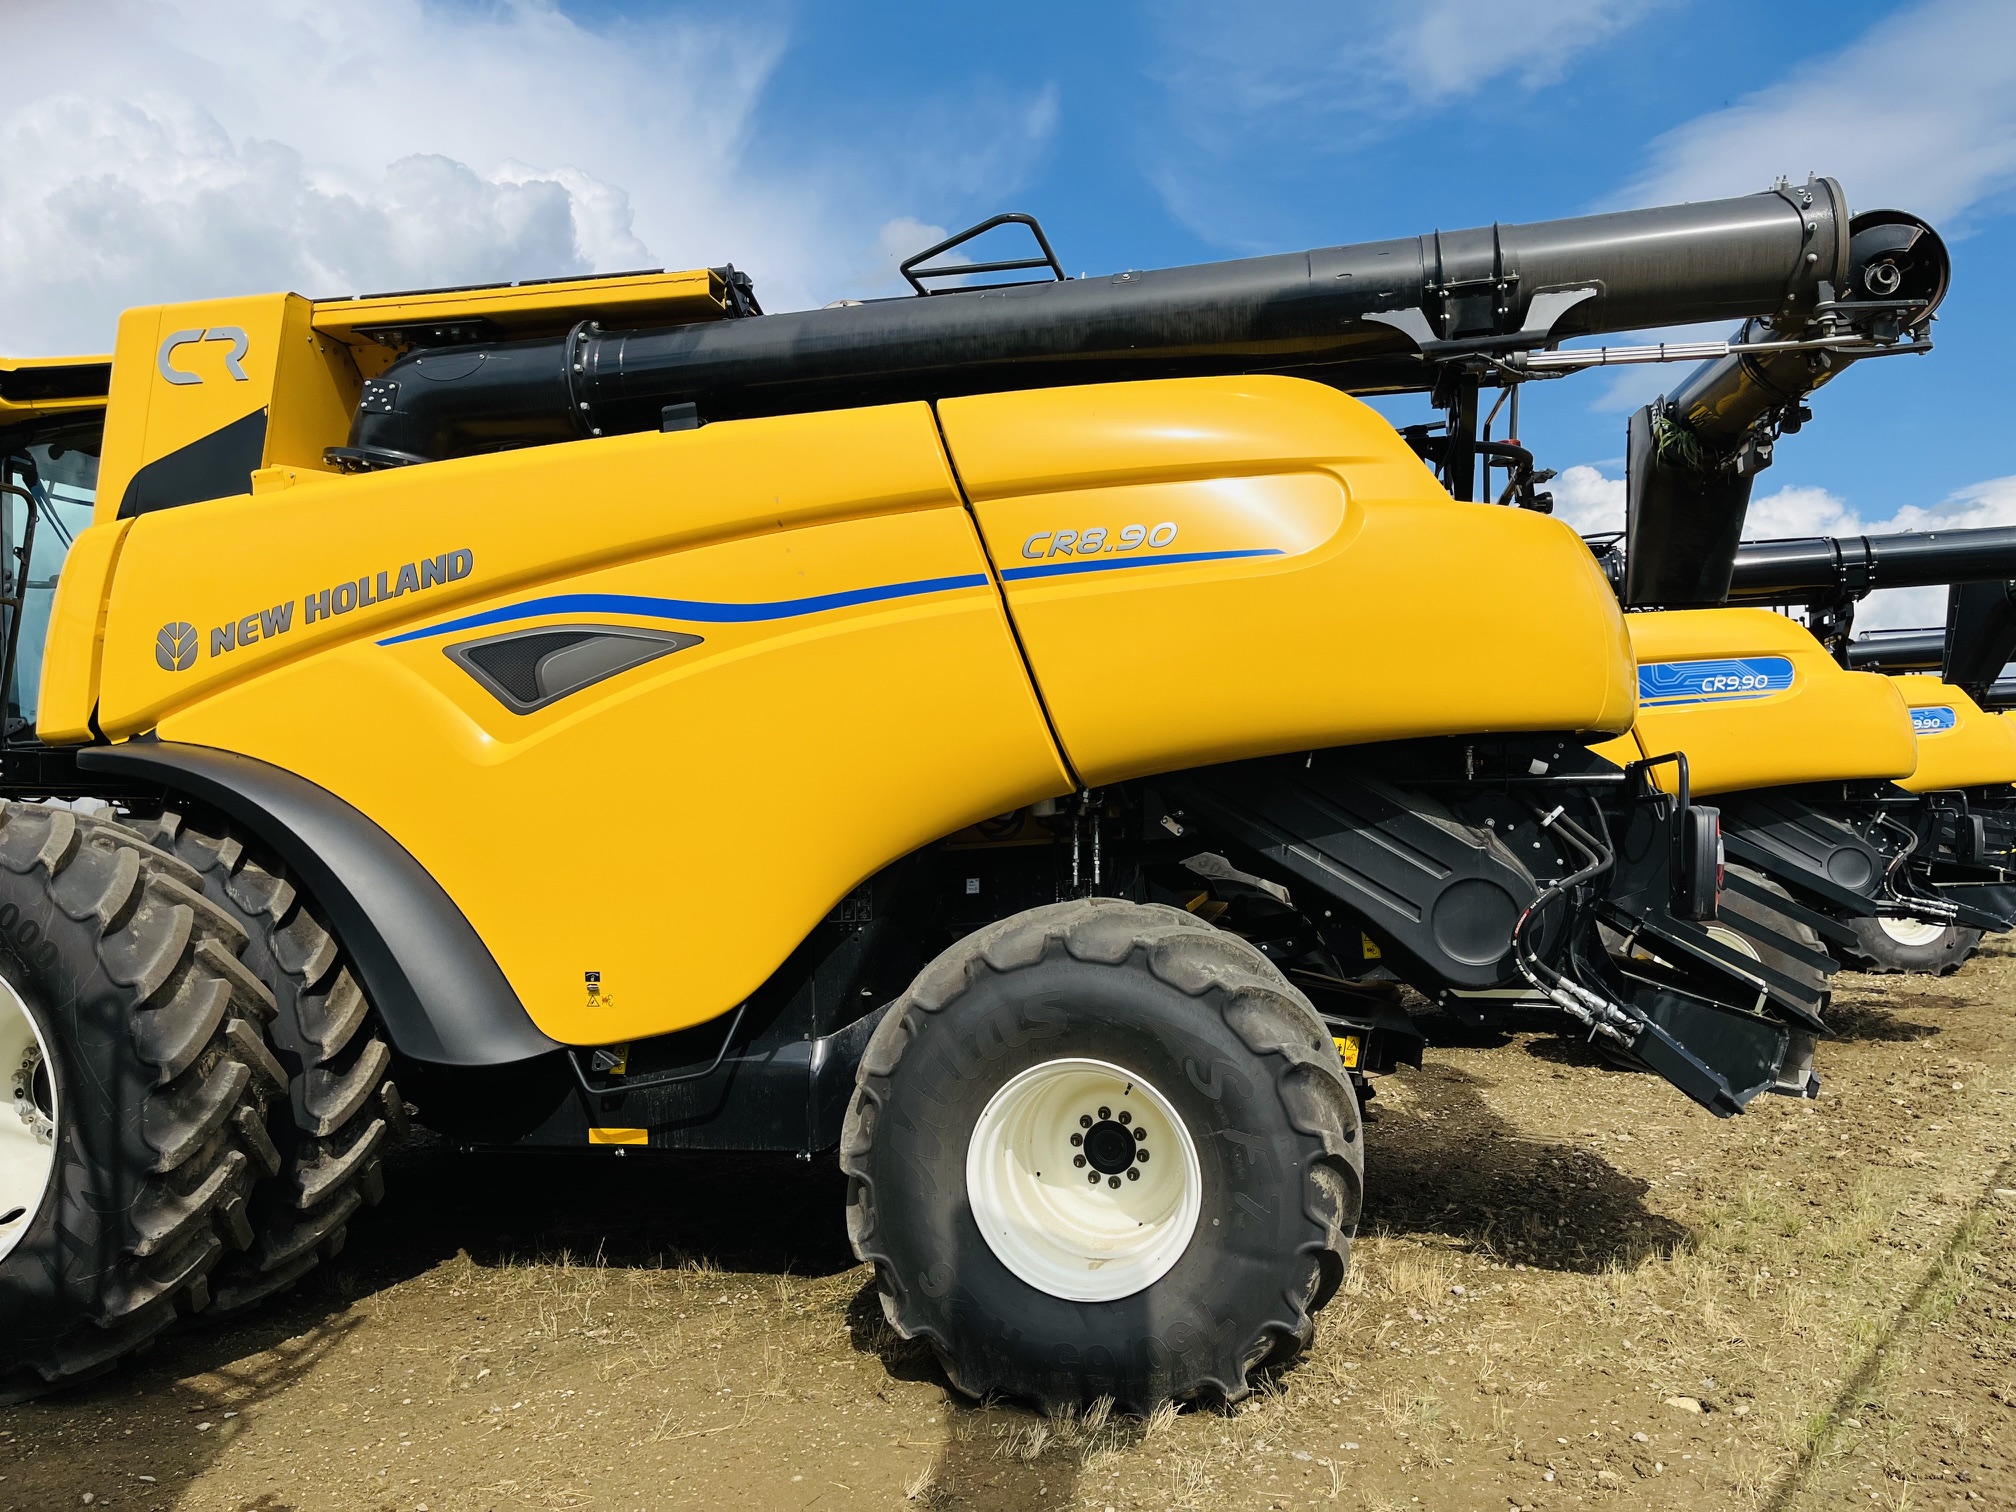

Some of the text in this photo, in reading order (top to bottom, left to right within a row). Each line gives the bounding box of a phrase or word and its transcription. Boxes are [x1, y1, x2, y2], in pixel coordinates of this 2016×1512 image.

[157, 326, 249, 386] CR
[1022, 522, 1178, 559] CR8.90
[210, 547, 474, 658] NEW HOLLAND
[1702, 674, 1769, 692] CR9.90
[889, 990, 1069, 1195] Mitas
